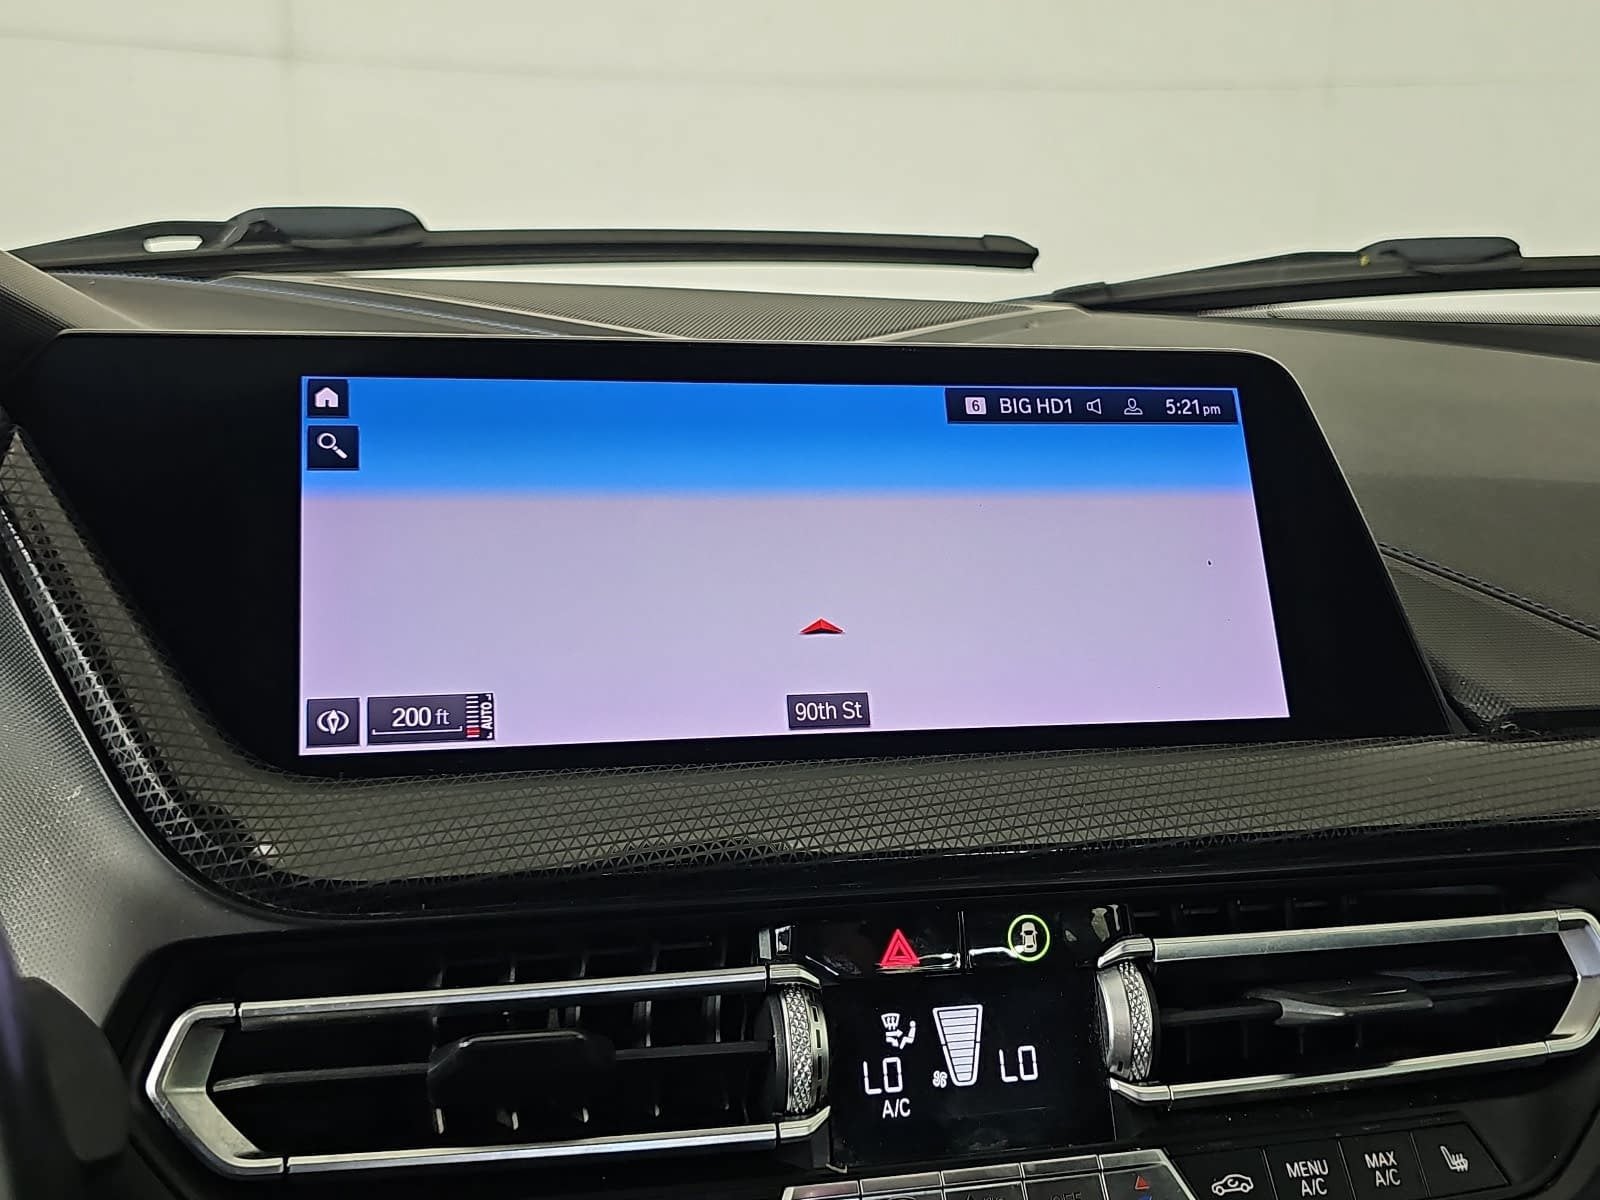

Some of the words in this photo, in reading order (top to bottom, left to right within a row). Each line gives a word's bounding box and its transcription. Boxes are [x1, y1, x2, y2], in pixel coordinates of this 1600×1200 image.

[1000, 398, 1031, 414] BIG
[1037, 398, 1073, 415] HD1
[391, 707, 432, 727] 200
[435, 708, 450, 725] ft
[480, 701, 493, 730] AUTO
[795, 702, 837, 721] 90th
[842, 701, 863, 719] St
[998, 1045, 1039, 1083] LO
[862, 1056, 903, 1095] LO
[882, 1098, 911, 1119] A/C
[1286, 1159, 1329, 1178] MENU
[1364, 1151, 1398, 1169] MAX
[1300, 1177, 1328, 1197] A/C
[1374, 1168, 1401, 1188] A/C
